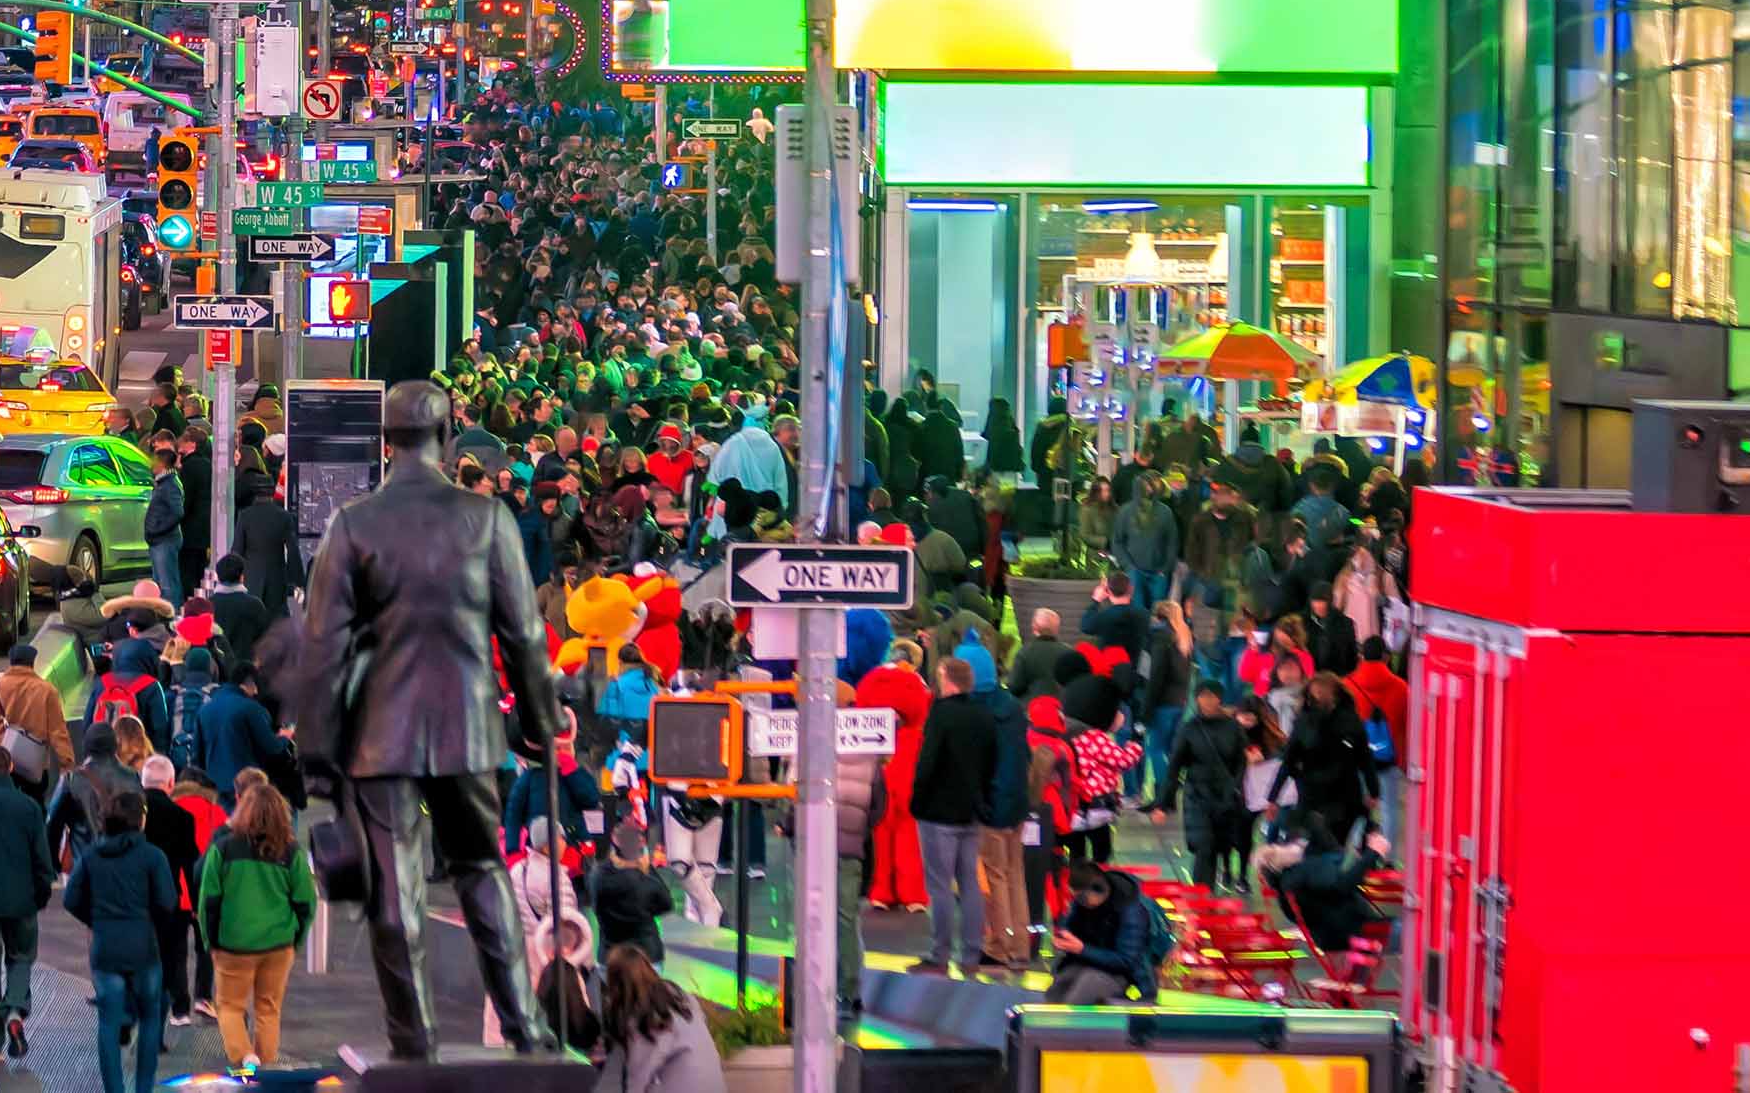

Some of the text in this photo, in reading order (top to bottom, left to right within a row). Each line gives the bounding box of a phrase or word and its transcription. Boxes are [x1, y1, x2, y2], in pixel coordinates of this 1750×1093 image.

[323, 163, 336, 178] W
[343, 162, 359, 178] 45
[260, 186, 275, 204] W
[283, 186, 303, 204] 45
[234, 212, 262, 229] George
[264, 213, 289, 227] Abbott
[262, 242, 323, 253] ONE WAY
[189, 306, 259, 318] ONE WAY
[784, 565, 891, 588] ONE WAY
